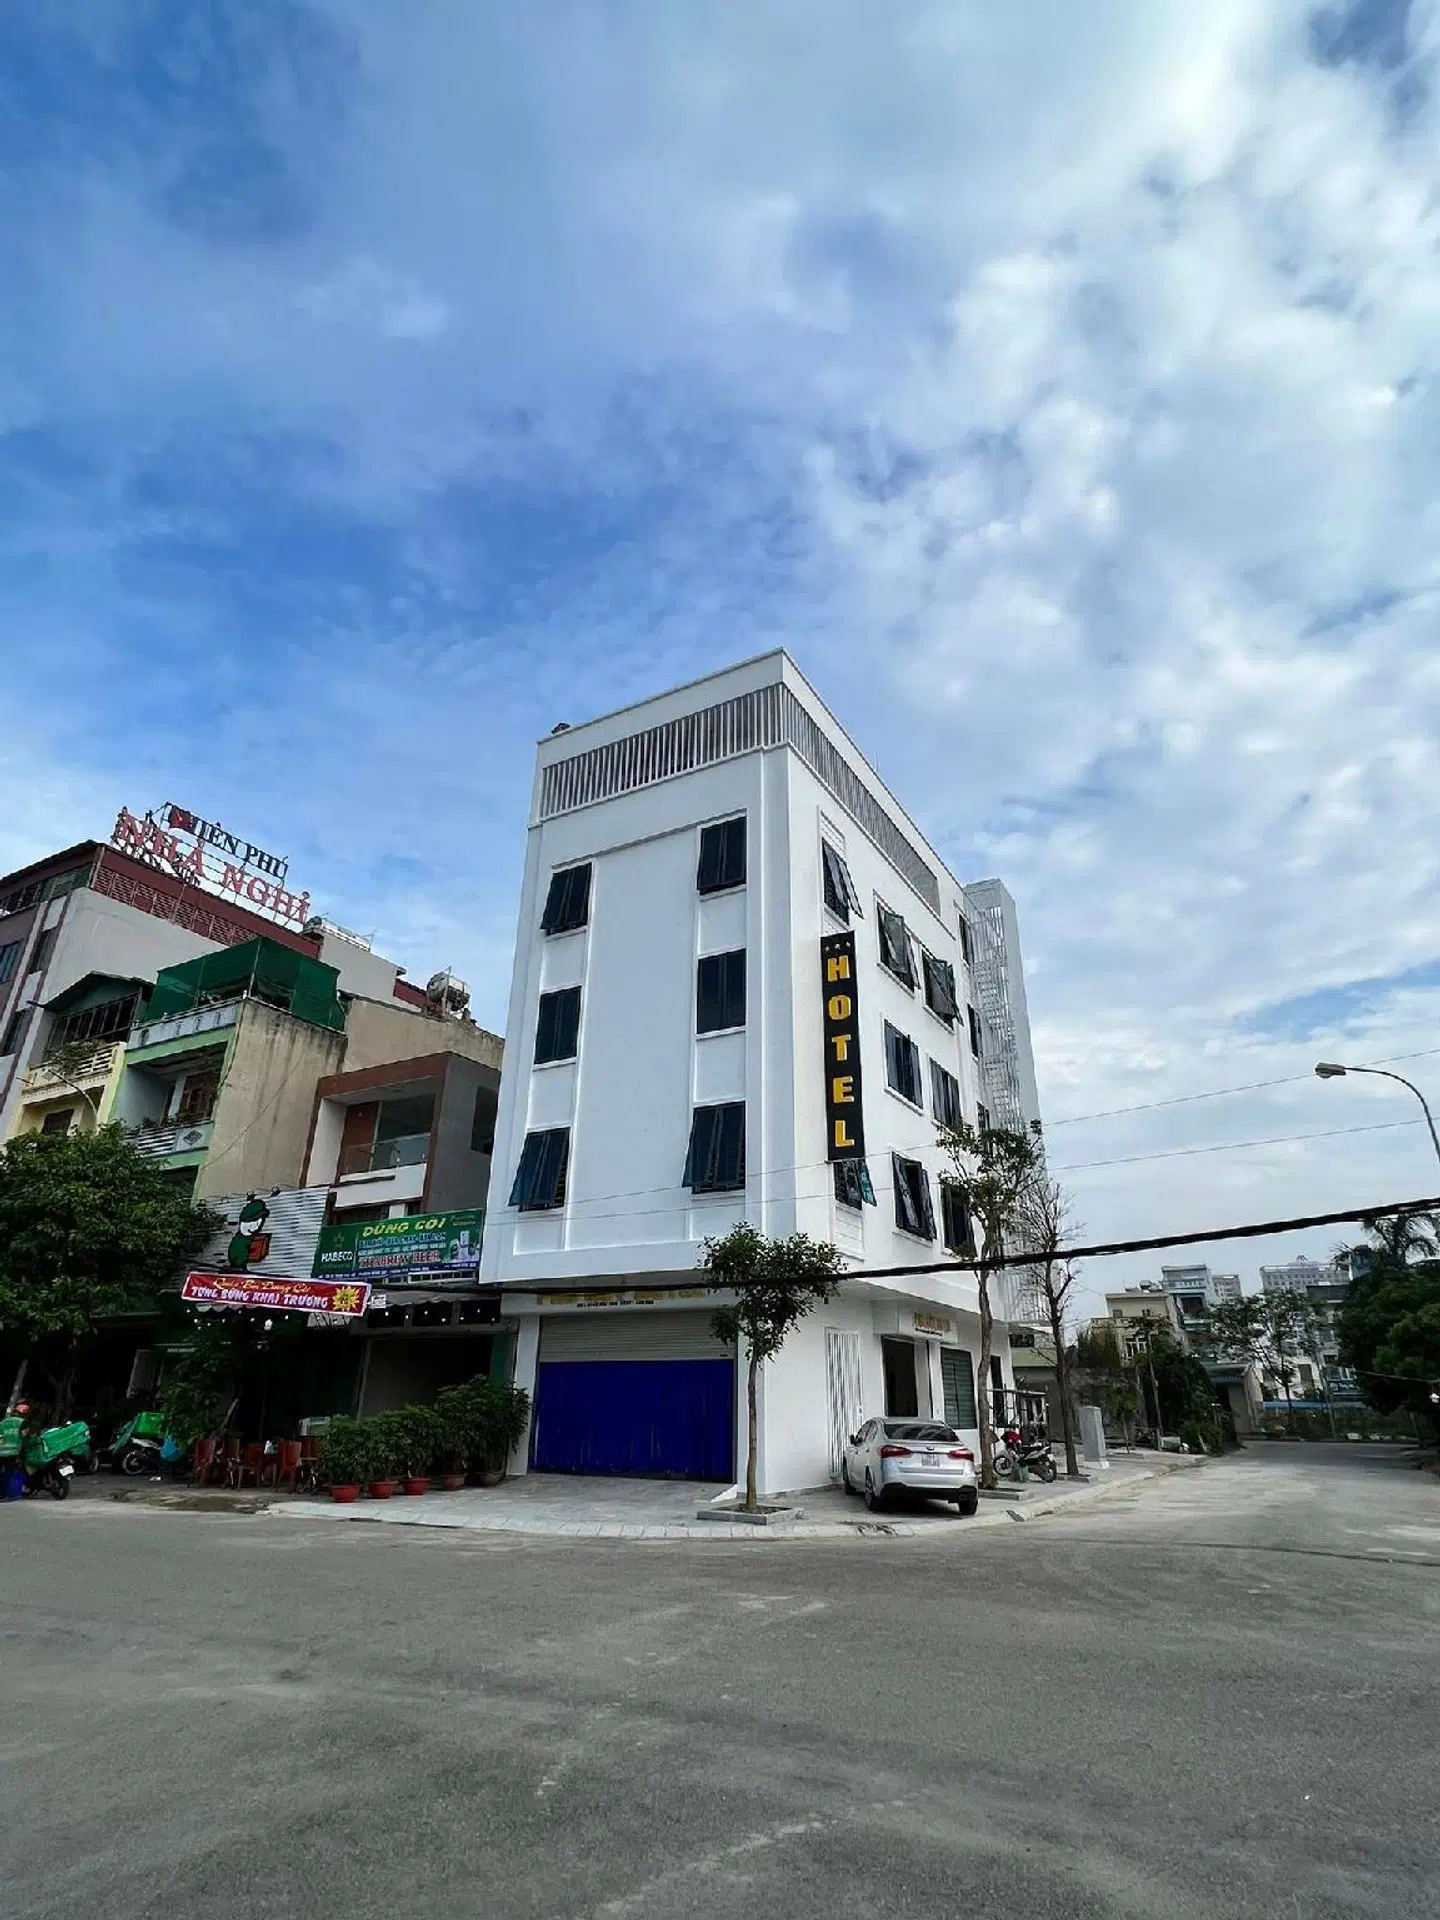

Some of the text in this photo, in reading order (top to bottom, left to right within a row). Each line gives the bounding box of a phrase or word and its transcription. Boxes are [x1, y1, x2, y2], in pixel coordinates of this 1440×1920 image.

[244, 843, 289, 880] PHÚ
[827, 955, 855, 1148] HOTEL
[321, 1251, 353, 1263] HABECO
[252, 1291, 280, 1304] KHAI
